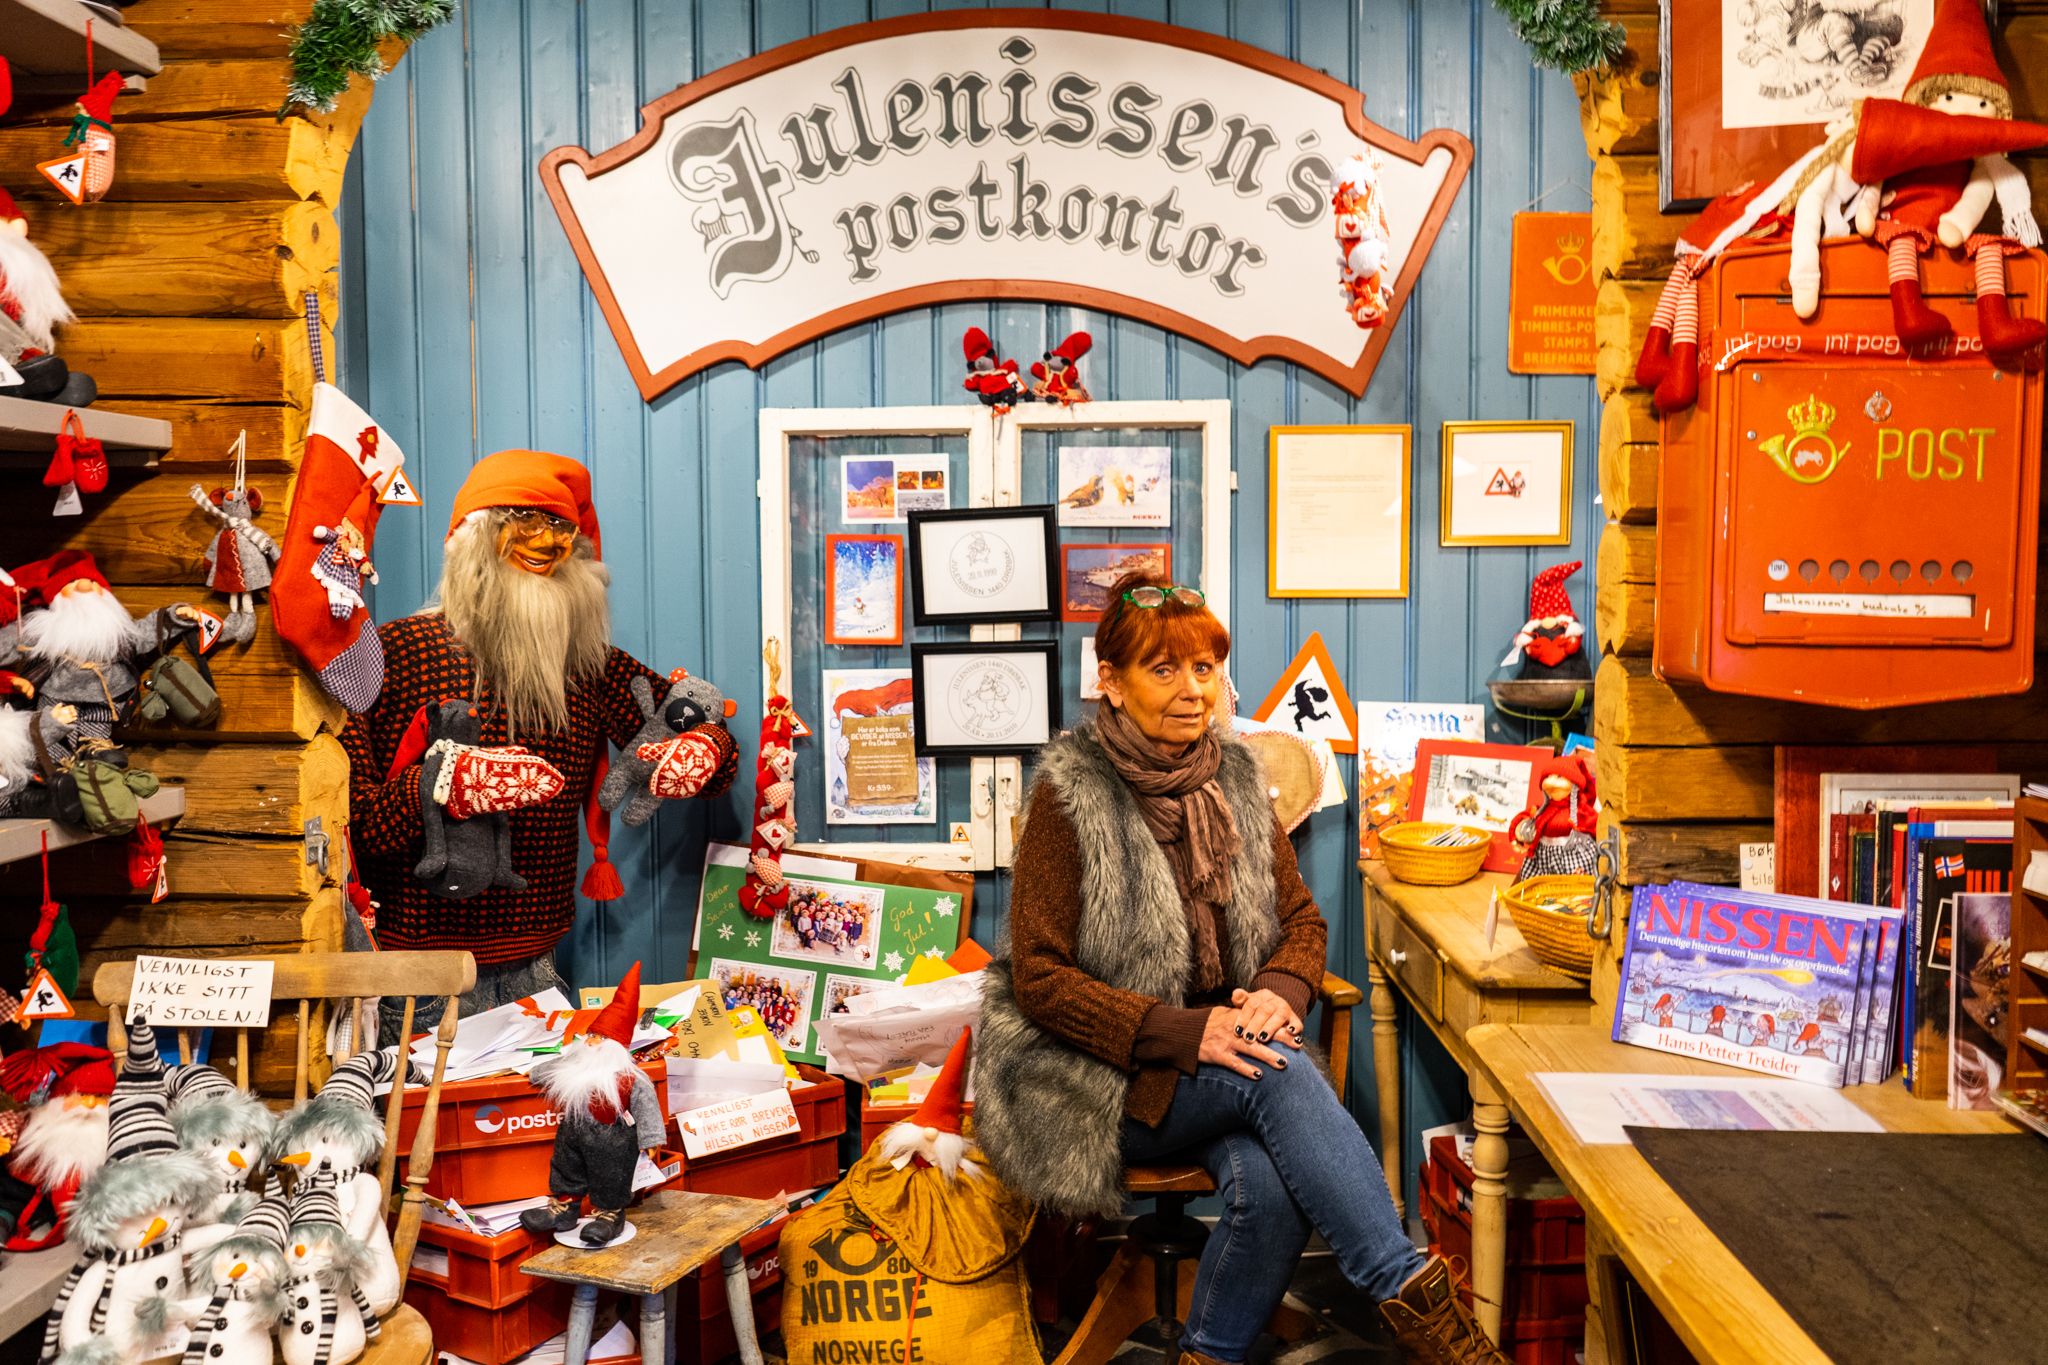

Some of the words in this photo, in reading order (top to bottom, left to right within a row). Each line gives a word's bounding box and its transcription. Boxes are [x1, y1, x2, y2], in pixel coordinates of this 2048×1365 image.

[835, 152, 1267, 298] postkontor
[1533, 305, 1596, 318] FRIMERKE
[1521, 320, 1597, 334] TIMBRES-PO
[1544, 336, 1589, 350] STAMPS
[1757, 334, 1801, 353] God
[1825, 333, 1852, 355] jul
[1856, 335, 1900, 356] God
[1523, 352, 1597, 366] BRIEFMARK
[1877, 428, 1995, 482] POST
[1752, 873, 1774, 886] tils
[1646, 893, 1855, 966] NISSEN
[1657, 936, 1691, 951] utrolige
[1690, 940, 1731, 955] historien
[1746, 949, 1770, 962] hans
[1769, 953, 1781, 965] liv
[1792, 959, 1850, 977] opprinnelse
[138, 959, 253, 978] VENNLIGST
[138, 981, 188, 996] IKKE
[202, 986, 254, 1000] SITT
[1658, 1033, 1695, 1052] Hans
[1699, 1041, 1744, 1063] Petter
[1745, 1049, 1801, 1075] Treider
[506, 1109, 566, 1134] poste
[702, 1120, 728, 1135] IKKE
[751, 1104, 794, 1123] BREVENE
[704, 1131, 745, 1151] HILSEN
[752, 1119, 790, 1138] NISSEN
[802, 1259, 818, 1278] 19
[800, 1277, 933, 1326] NORGE
[812, 1337, 924, 1365] NORVEGE
